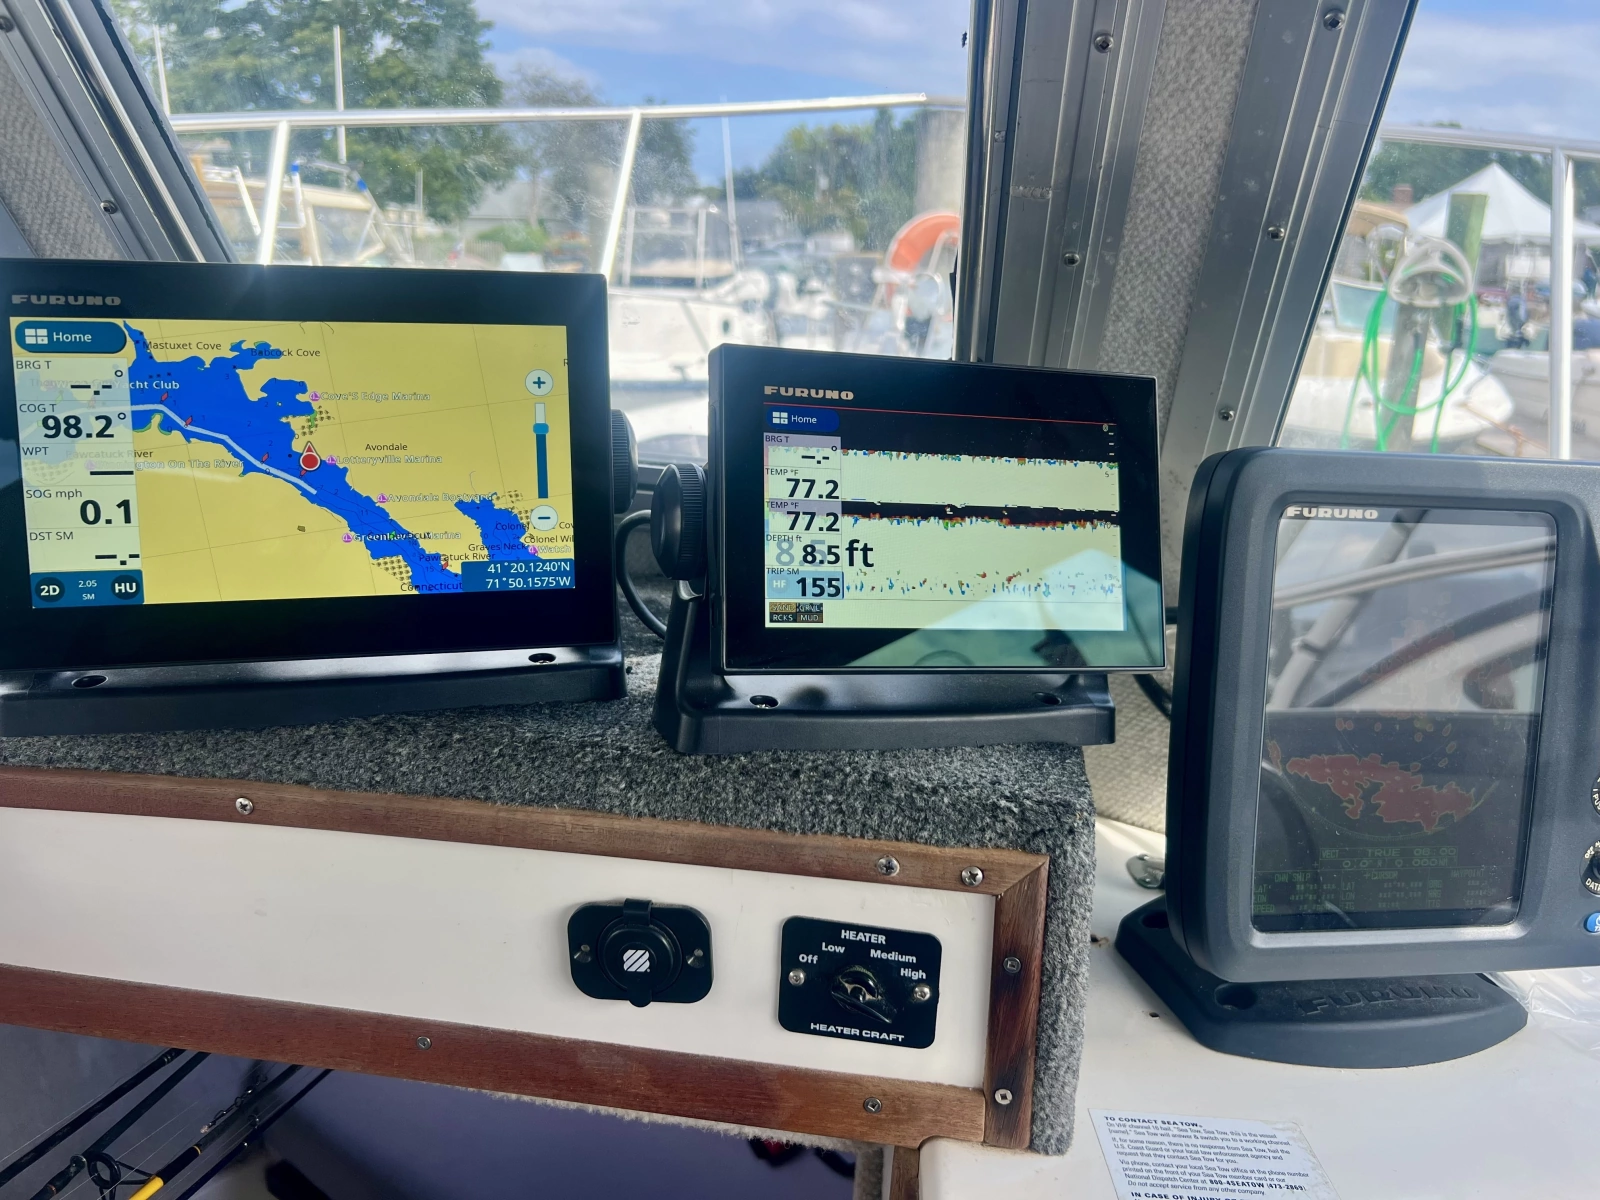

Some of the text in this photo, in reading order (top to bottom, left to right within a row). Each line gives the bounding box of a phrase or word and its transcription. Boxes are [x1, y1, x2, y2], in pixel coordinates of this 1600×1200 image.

[11, 294, 121, 306] FURUNO
[53, 332, 92, 342] Home
[143, 341, 222, 350] Mastuxet Cove
[250, 348, 321, 358] Babcock Cove
[16, 360, 52, 370] BRG T
[153, 380, 180, 390] Club
[362, 392, 388, 402] Edge
[392, 392, 430, 401] Marina
[764, 386, 854, 400] FURUNO
[19, 404, 56, 412] COG T
[792, 415, 817, 424] Home
[22, 447, 48, 455] WPT
[365, 443, 408, 451] Avondale
[127, 450, 153, 458] River
[168, 460, 185, 468] On
[189, 460, 211, 468] The
[214, 460, 244, 468] River
[337, 454, 443, 466] Lotteryville Marina
[786, 478, 840, 500] 77.2
[26, 489, 82, 500] SOG mph
[388, 493, 439, 502] Avondale
[80, 499, 132, 525] 0.1
[1286, 507, 1378, 520] FURUNO
[786, 511, 840, 532] 77.2
[30, 532, 74, 540] DST SM
[524, 536, 558, 544] Colonel
[539, 545, 571, 553] Watch
[846, 539, 874, 568] ft
[802, 544, 840, 565] 8.5
[78, 580, 97, 588] 2.05
[114, 582, 136, 593] HU
[400, 582, 462, 592] Connecticut
[796, 577, 840, 598] 155
[40, 585, 60, 596] 2D
[1368, 848, 1400, 857] TRUE
[841, 930, 886, 944] HEATER
[822, 942, 845, 953] Low
[799, 954, 818, 964] Off
[870, 950, 916, 963] Medium
[900, 968, 926, 980] High
[1298, 985, 1480, 1016] FURUNO
[810, 1023, 905, 1042] HEATER CRAFT
